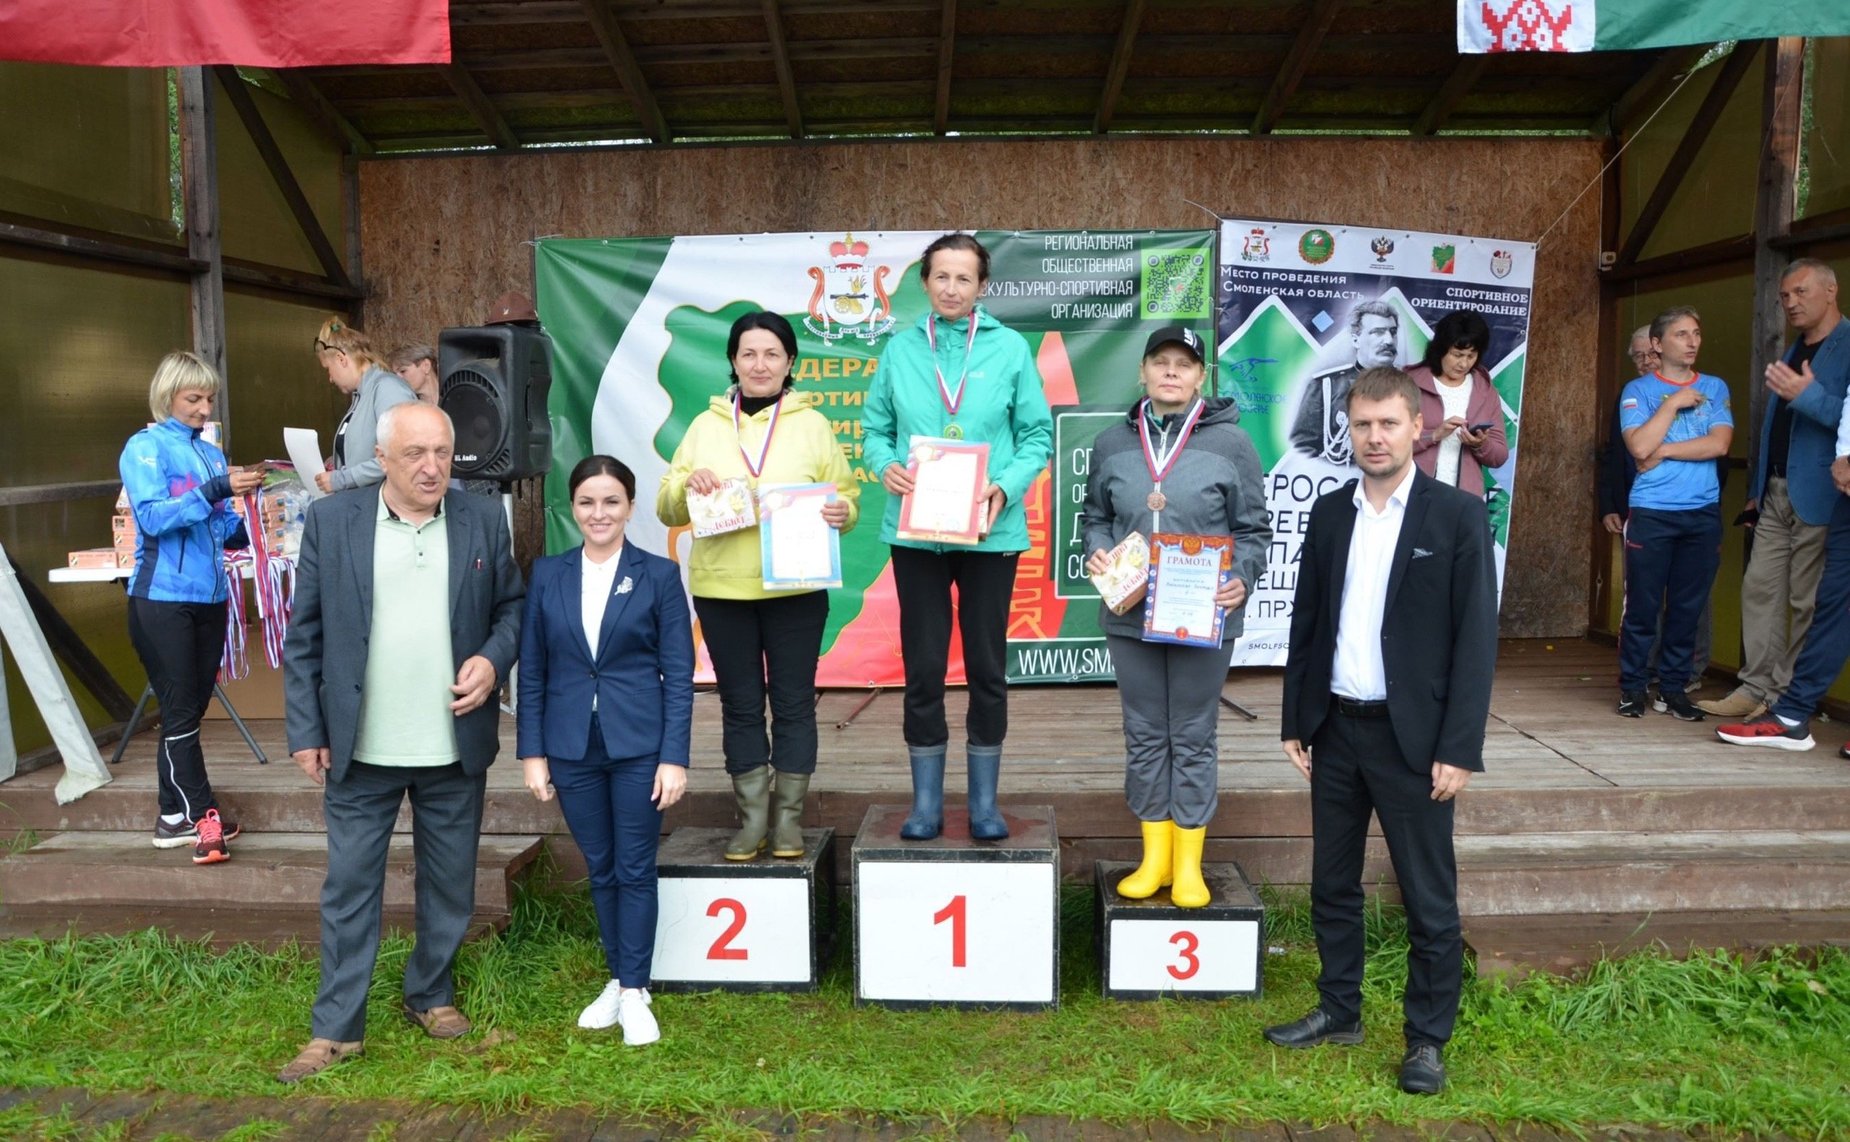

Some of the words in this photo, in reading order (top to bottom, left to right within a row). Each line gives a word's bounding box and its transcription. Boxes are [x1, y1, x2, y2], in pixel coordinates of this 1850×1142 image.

[1044, 235, 1134, 251] РЕГИОНАЛЬНАЯ
[1041, 258, 1134, 274] ОБЩЕСТВЕННАЯ
[1446, 287, 1529, 304] СПОРТИВНОЕ
[1051, 303, 1133, 319] ОРГАНИЗАЦИЯ
[1411, 297, 1528, 317] ОРИЕНТИРОВАНИЕ
[1167, 556, 1212, 567] ГРАМОТА
[1018, 648, 1115, 675] WWW.SM
[706, 898, 748, 960] 2
[933, 895, 967, 968] 1
[1166, 931, 1200, 980] 3
